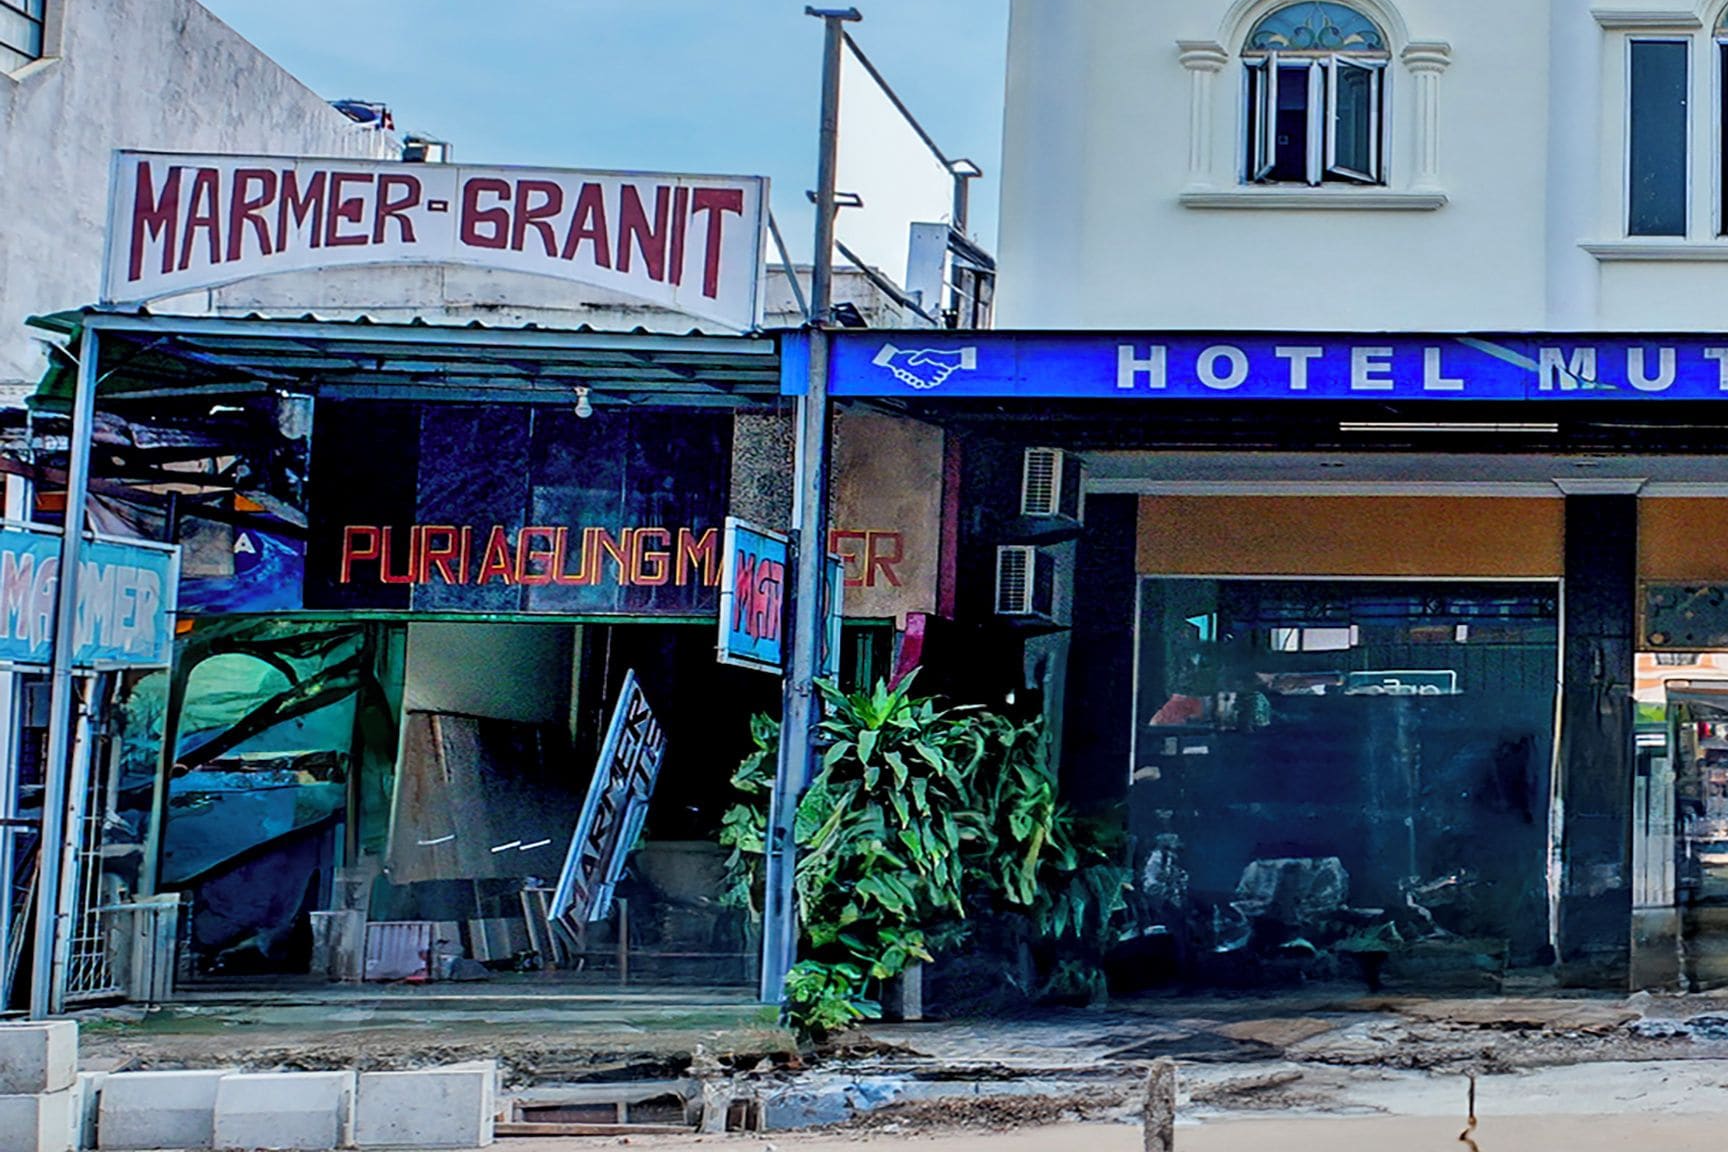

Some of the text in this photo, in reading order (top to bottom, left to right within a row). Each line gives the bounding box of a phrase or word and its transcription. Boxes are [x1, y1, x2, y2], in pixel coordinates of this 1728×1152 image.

[1115, 344, 1466, 391] HOTEL
[340, 525, 904, 587] PURI AGUNG MER
[0, 549, 161, 656] MAMER
